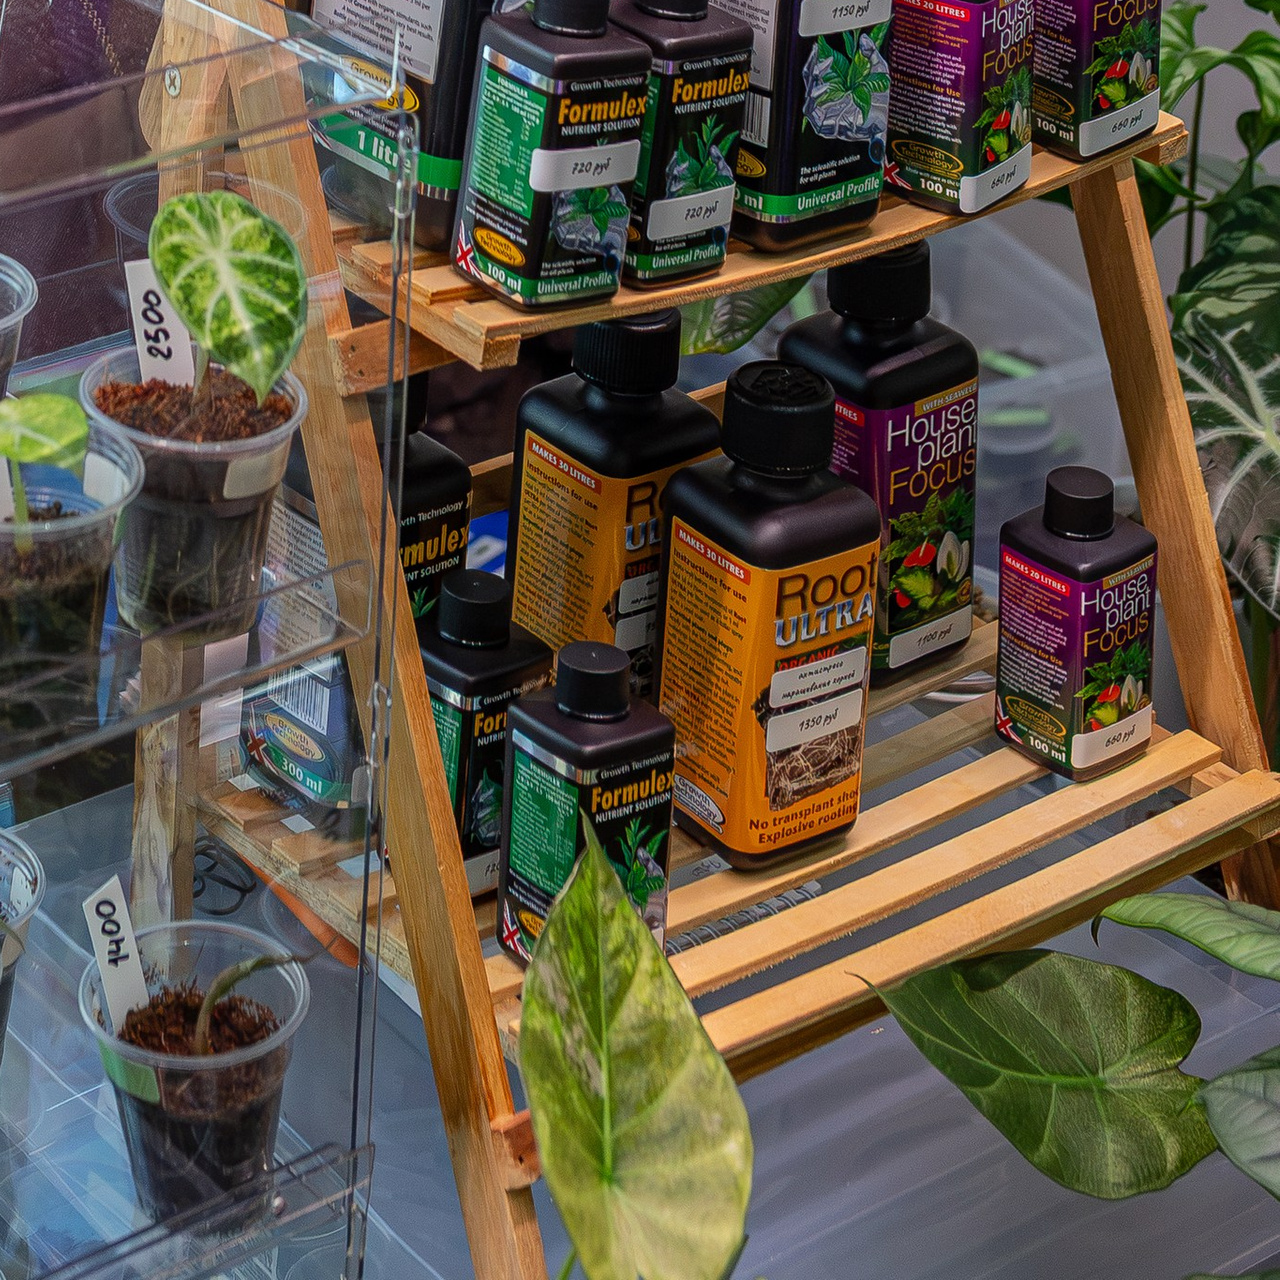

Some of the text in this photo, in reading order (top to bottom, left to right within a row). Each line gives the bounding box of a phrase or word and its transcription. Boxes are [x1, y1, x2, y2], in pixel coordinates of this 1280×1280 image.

[832, 5, 854, 19] 1150
[923, 0, 934, 11] 20
[935, 4, 965, 18] LITRES
[1000, 4, 1035, 53] plant
[683, 60, 711, 71] Growth
[982, 34, 1033, 81] Focus
[571, 82, 601, 92] Growth
[672, 68, 750, 103] Formulex
[932, 83, 961, 97] for Use
[558, 91, 647, 125] Formulex
[674, 93, 745, 114] NUTRIENT SOLUTION
[358, 130, 365, 151] 1
[561, 118, 641, 136] NUTRIENT SOLUTION
[1037, 118, 1056, 134] 100
[1059, 130, 1074, 141] ml
[901, 145, 954, 170] Technology
[909, 143, 945, 160] Growth
[797, 177, 880, 210] Universal Profile
[920, 178, 943, 193] 100
[744, 195, 763, 209] ml
[480, 236, 517, 263] Technology
[485, 231, 511, 252] Growth
[652, 244, 720, 268] Universal Profile
[487, 263, 522, 291] 100 ml
[537, 271, 612, 294] Universal Profile
[141, 289, 172, 361] 2500
[835, 403, 858, 421] ITRES
[922, 398, 944, 412] WITH
[887, 398, 976, 452] House
[918, 416, 977, 471] plant
[532, 442, 596, 489] MAKES 30 LITRES
[889, 448, 976, 505] Focus
[527, 461, 598, 511] Instructions for use
[417, 501, 463, 521] Technology
[400, 523, 469, 567] mulex
[679, 529, 705, 553] MAKES
[706, 548, 716, 561] 30
[718, 556, 745, 579] LITRES
[420, 556, 459, 577] SOLUTION
[673, 547, 747, 603] Instructions for use
[1005, 555, 1066, 592] MAKES 20 LITRES
[776, 551, 877, 617] Root
[1081, 573, 1148, 616] House
[774, 591, 873, 646] ULTRA
[1106, 585, 1150, 632] plant
[1084, 612, 1148, 658] Focus
[798, 708, 838, 732] 1350 руб
[1029, 736, 1049, 754] 100
[1051, 749, 1066, 762] ml
[281, 757, 322, 794] 300 ml
[600, 752, 670, 780] Growth Technology
[591, 769, 675, 813] Formulex
[678, 777, 711, 807] Growth
[595, 791, 671, 823] NUTRIENT SOLUTION
[749, 799, 834, 831] No transplant
[758, 801, 857, 844] Explosive rooting
[95, 898, 130, 968] 1400
